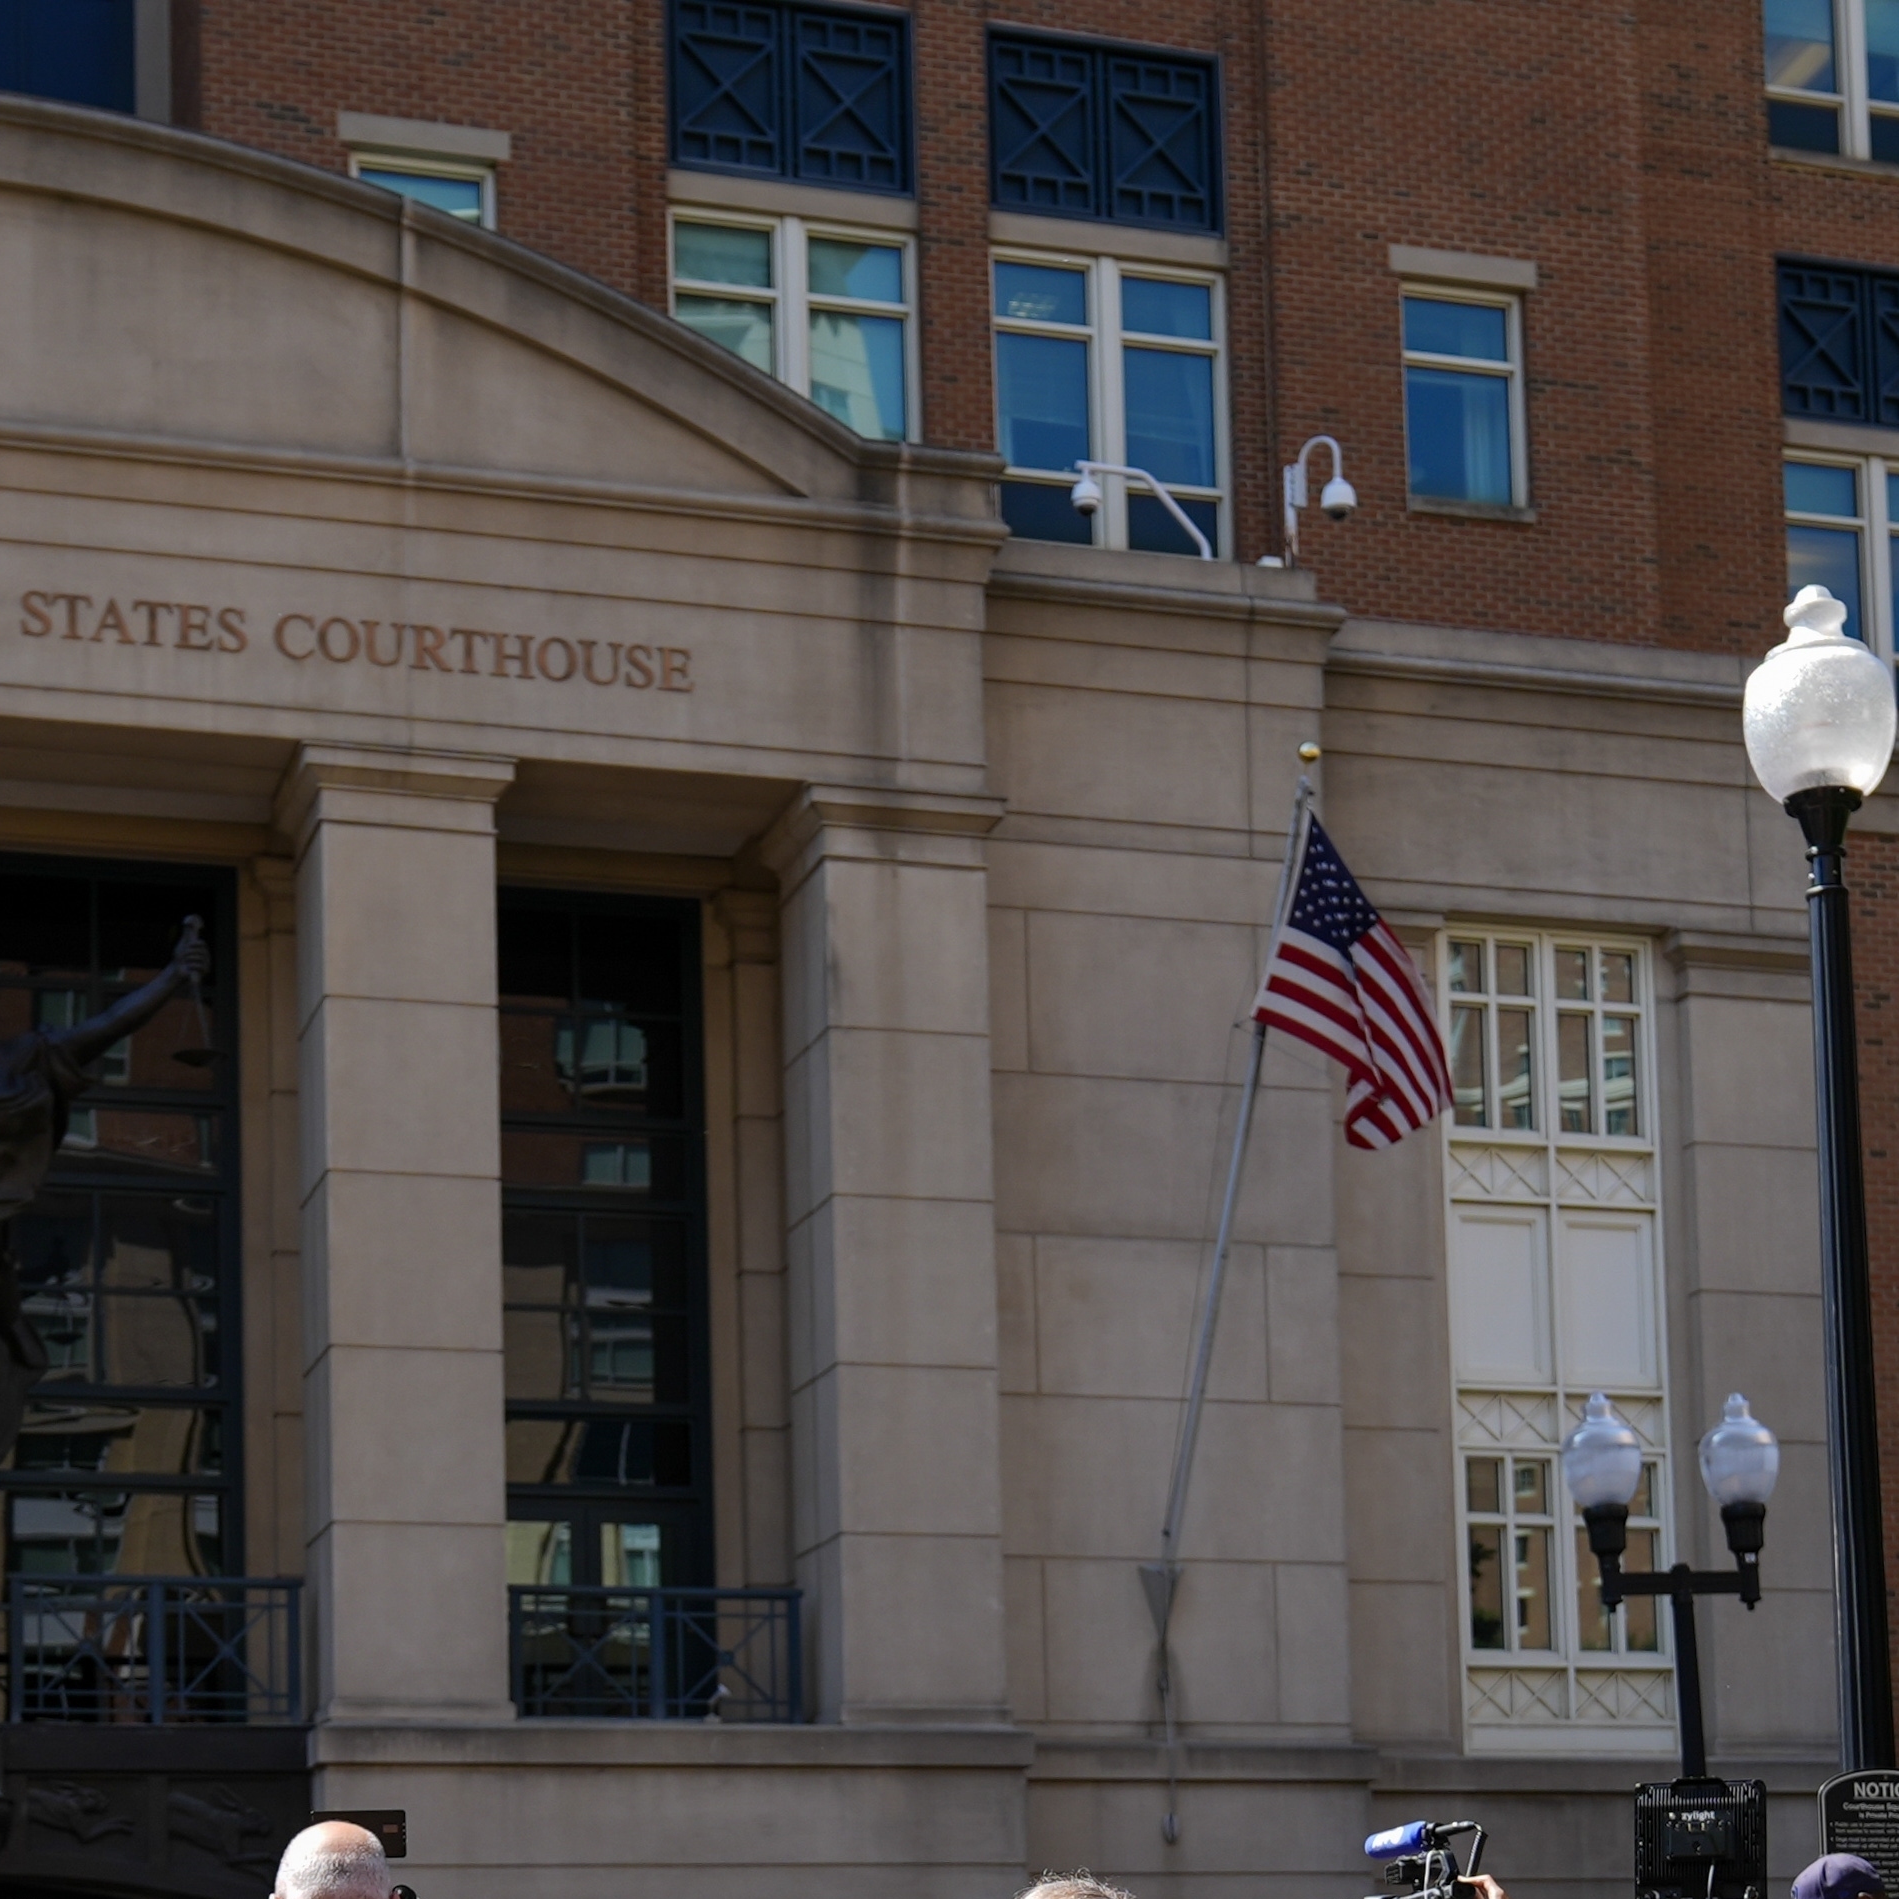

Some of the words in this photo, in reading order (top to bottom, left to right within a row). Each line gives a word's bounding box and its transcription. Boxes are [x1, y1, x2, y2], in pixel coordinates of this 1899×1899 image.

[19, 588, 249, 655] STATES
[273, 612, 696, 694] COURTHOUSE
[1681, 1810, 1716, 1820] zylight
